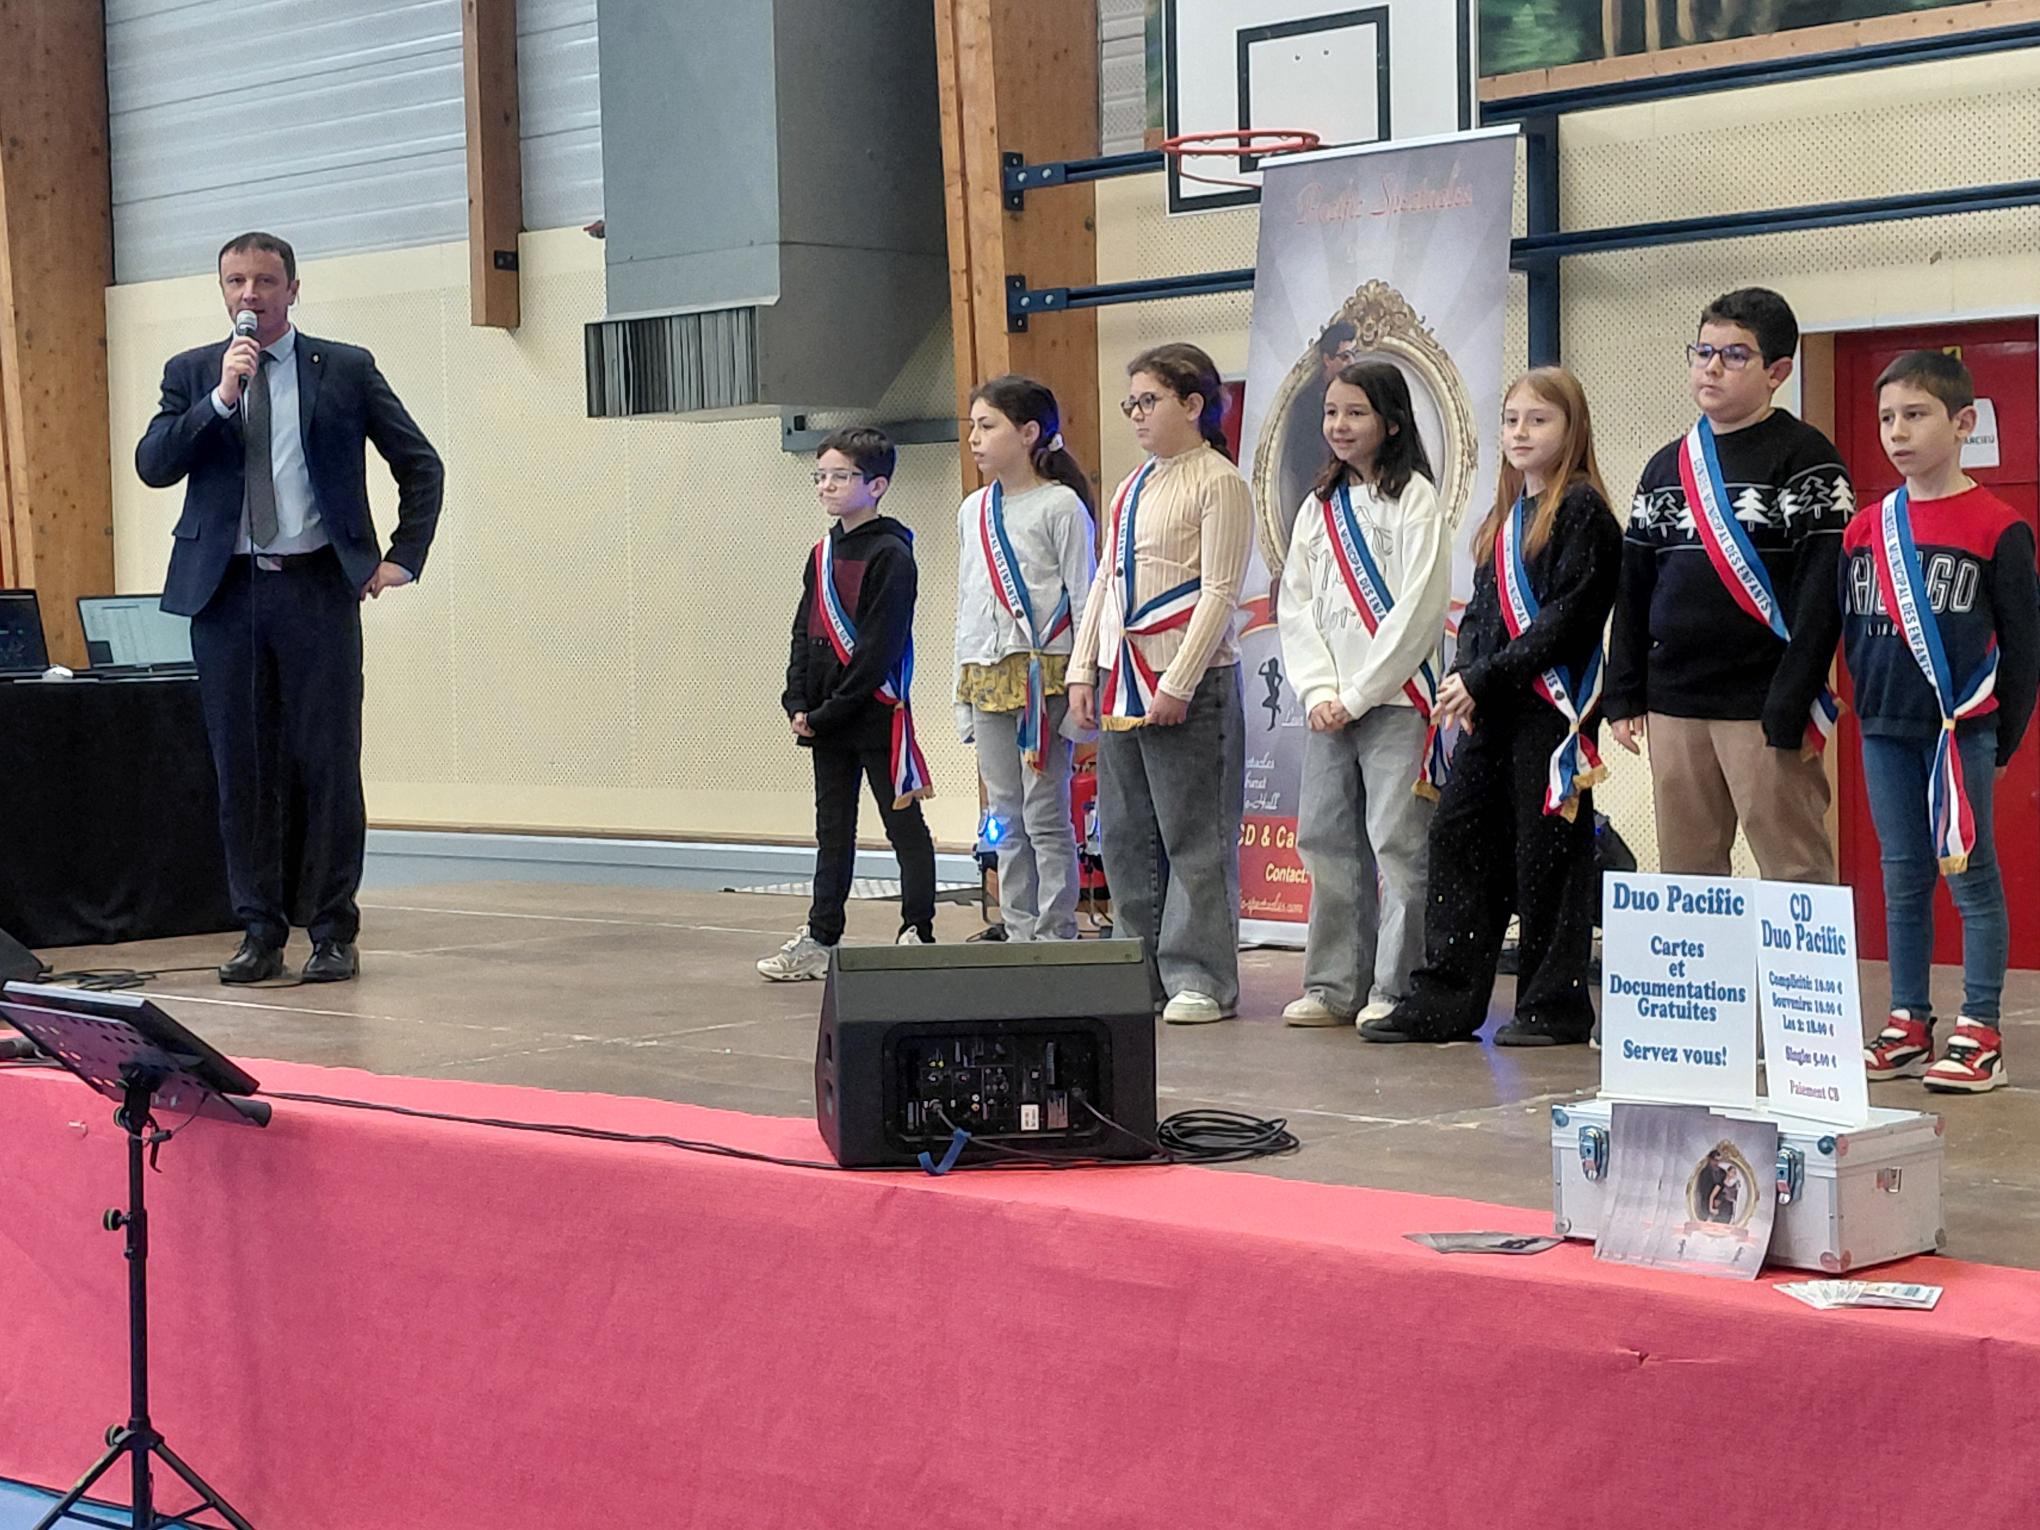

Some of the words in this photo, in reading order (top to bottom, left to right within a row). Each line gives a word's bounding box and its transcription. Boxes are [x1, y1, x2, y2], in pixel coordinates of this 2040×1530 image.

[1725, 544, 1742, 566] DES
[1737, 565, 1769, 612] ENFANTS
[1889, 543, 1911, 600] MUNICIPAL
[1000, 568, 1019, 607] ENFANTS
[1360, 577, 1374, 597] DES
[1369, 596, 1387, 622] ENFA
[1902, 602, 1916, 624] DES
[1908, 626, 1932, 677] ENFANTS
[1261, 825, 1271, 847] &
[1276, 826, 1295, 848] Ca
[1612, 883, 1660, 912] Duo
[1667, 885, 1744, 916] Pacific
[1790, 893, 1812, 922] CD
[1650, 936, 1704, 958] Cartes
[1761, 919, 1791, 950] Duo
[1796, 924, 1846, 956] Pacific
[1669, 961, 1686, 977] et
[1610, 974, 1746, 1002] Documentations
[1637, 998, 1717, 1021] Gratuites
[1623, 1039, 1678, 1064] Servez
[1683, 1047, 1728, 1066] vous!
[1790, 1079, 1826, 1099] Paiement
[1828, 1087, 1840, 1101] CB
